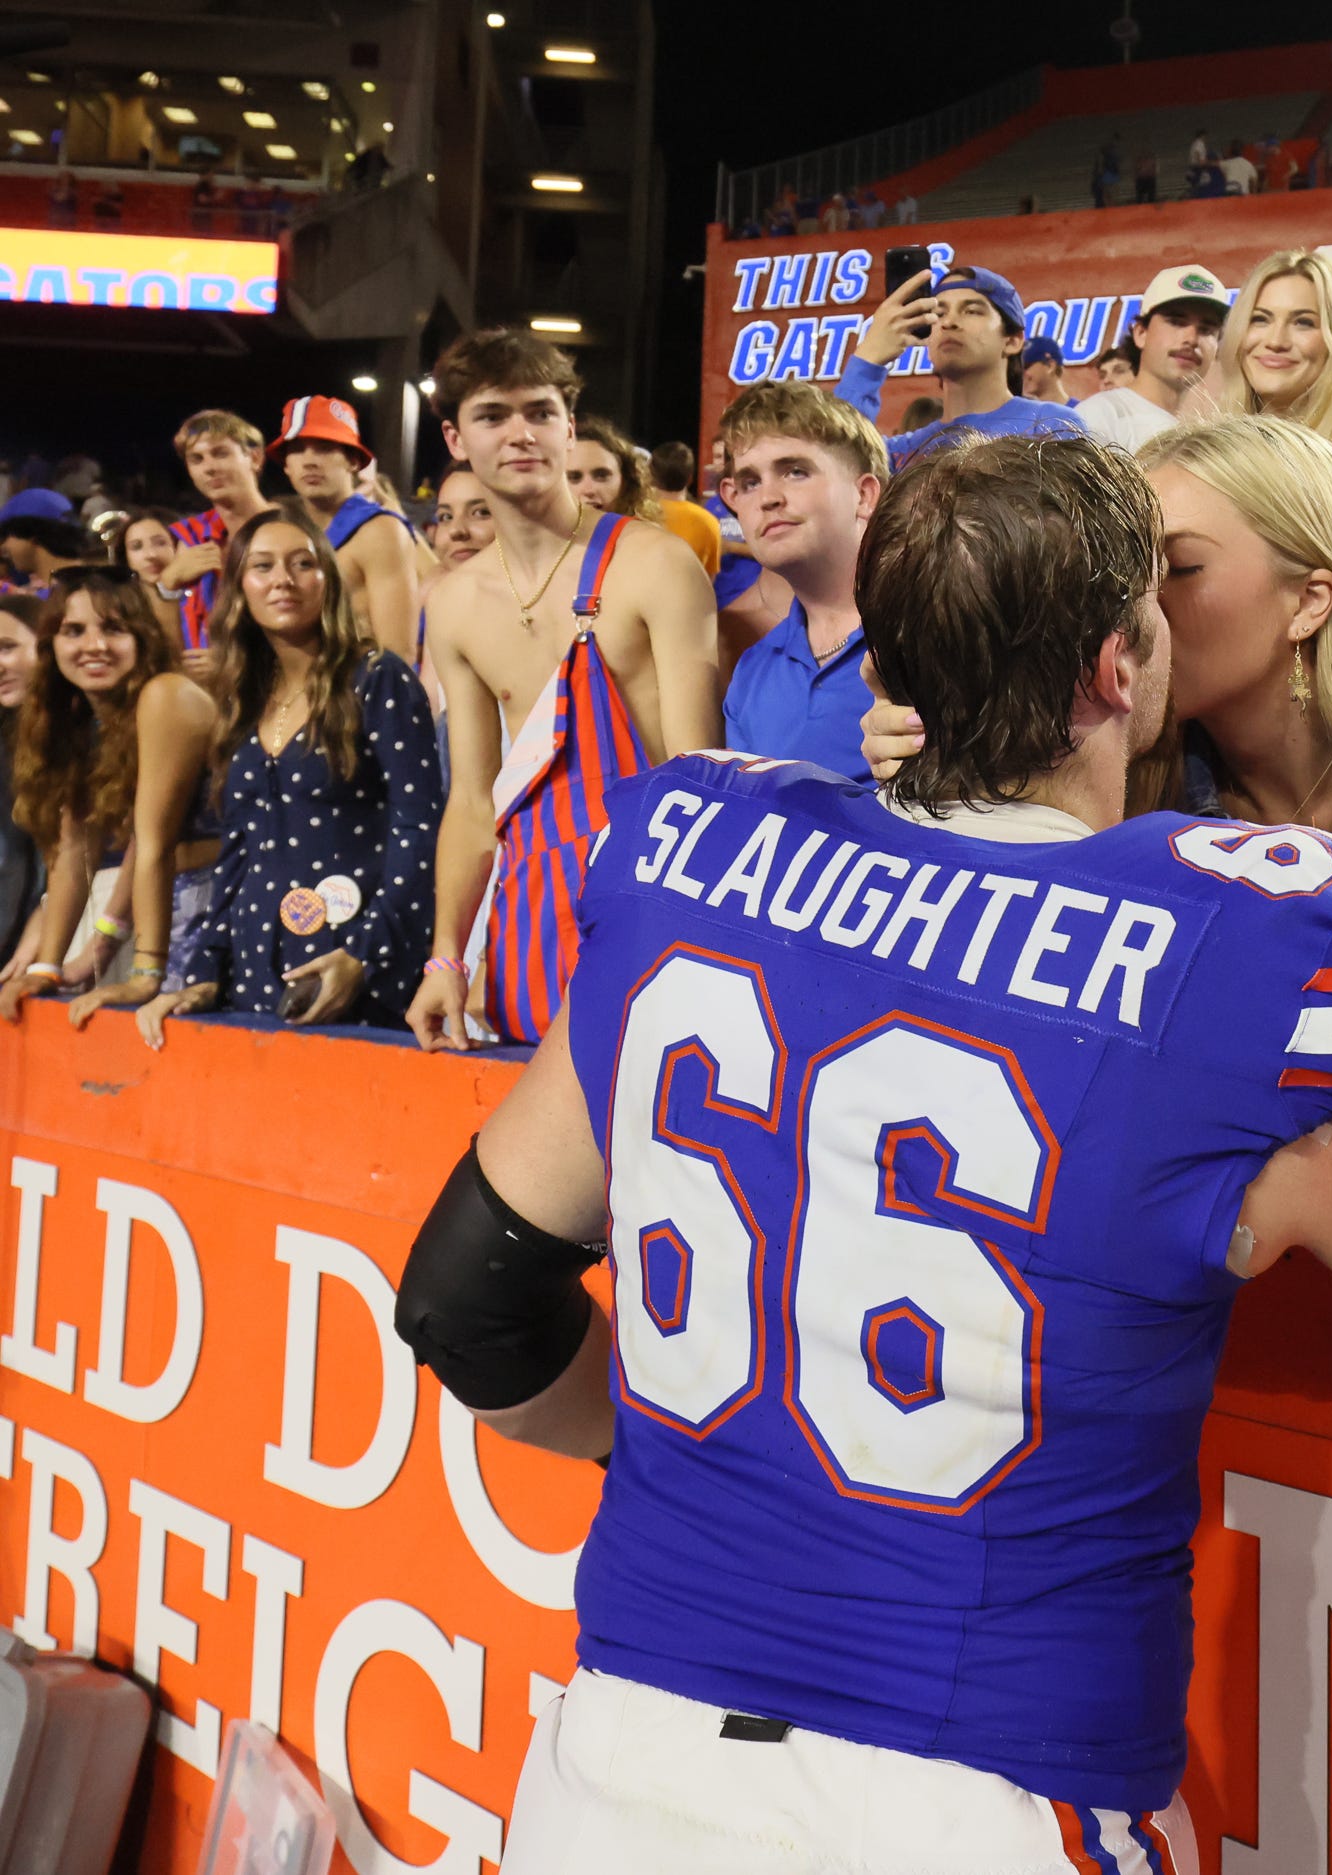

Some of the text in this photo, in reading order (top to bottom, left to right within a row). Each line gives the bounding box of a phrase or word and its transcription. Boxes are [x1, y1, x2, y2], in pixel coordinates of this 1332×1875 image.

[732, 249, 873, 313] THIS
[633, 788, 1177, 1032] SLAUGHTER
[604, 940, 1062, 1517] 66
